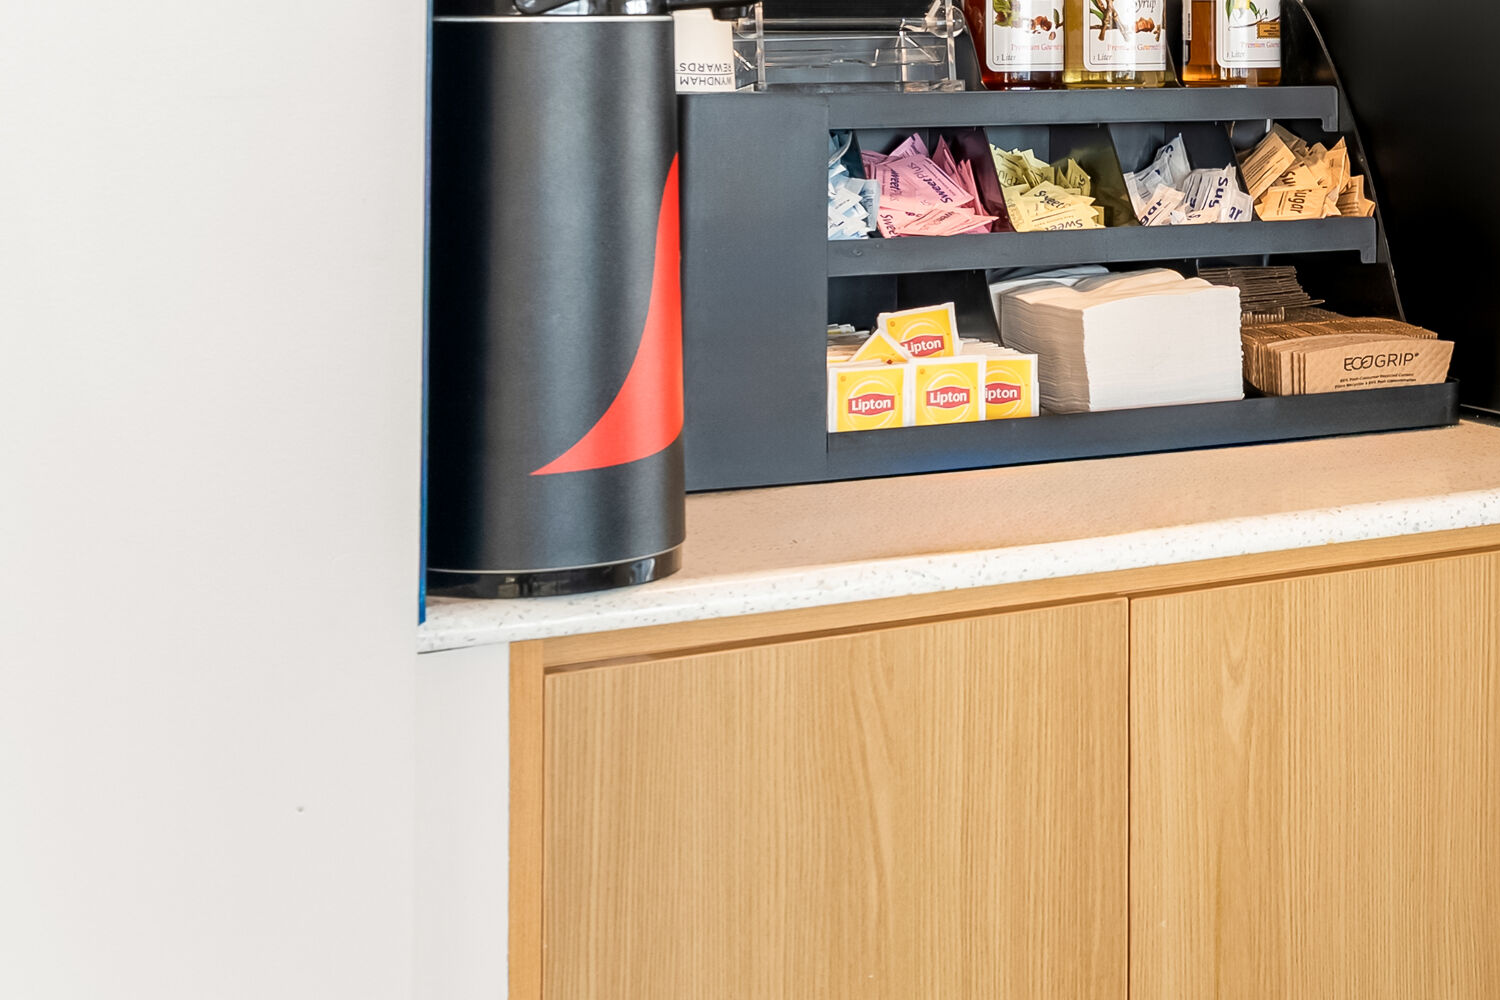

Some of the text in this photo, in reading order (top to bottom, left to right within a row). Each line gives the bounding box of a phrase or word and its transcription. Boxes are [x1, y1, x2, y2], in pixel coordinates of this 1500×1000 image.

[679, 62, 732, 72] REWARDS
[679, 76, 732, 86] WYNDHAM
[1288, 189, 1308, 214] ugar
[904, 339, 942, 355] Lipton
[1343, 352, 1415, 372] ECOGRIP
[929, 390, 968, 406] Lipton
[984, 387, 1018, 402] ipton
[851, 397, 892, 414] Lipton
